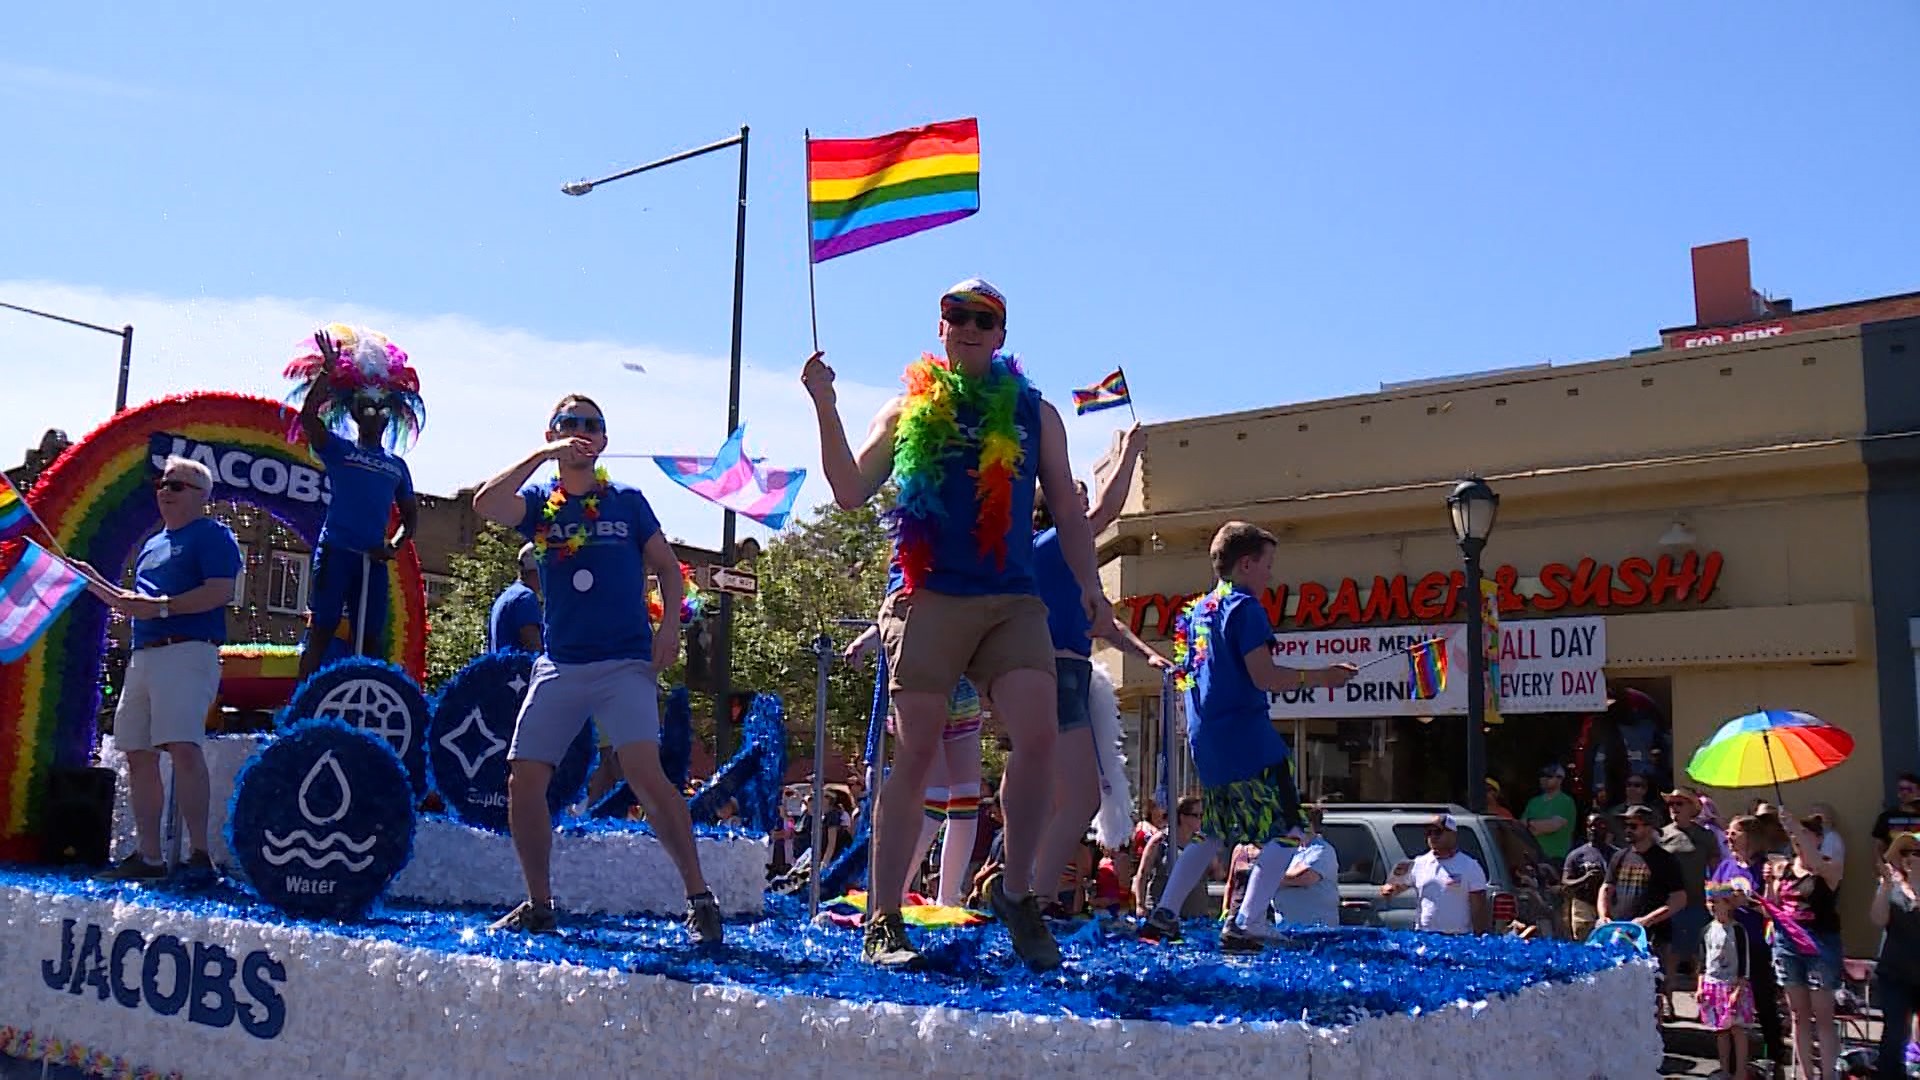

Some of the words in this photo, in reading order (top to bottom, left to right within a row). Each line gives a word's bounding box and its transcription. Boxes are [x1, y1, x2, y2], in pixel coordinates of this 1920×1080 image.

[1124, 584, 1288, 636] TYN
[1495, 564, 1526, 613] &
[1532, 549, 1724, 611] SUSHI
[1316, 637, 1372, 655] HOUR
[1379, 634, 1437, 652] MEN
[1501, 628, 1541, 660] ALL
[1551, 625, 1598, 659] DAY
[1346, 680, 1437, 703] DRIN
[1501, 671, 1554, 698] EVERY
[1562, 670, 1598, 696] DAY
[286, 875, 337, 894] Water
[42, 918, 287, 1040] JACOBS
